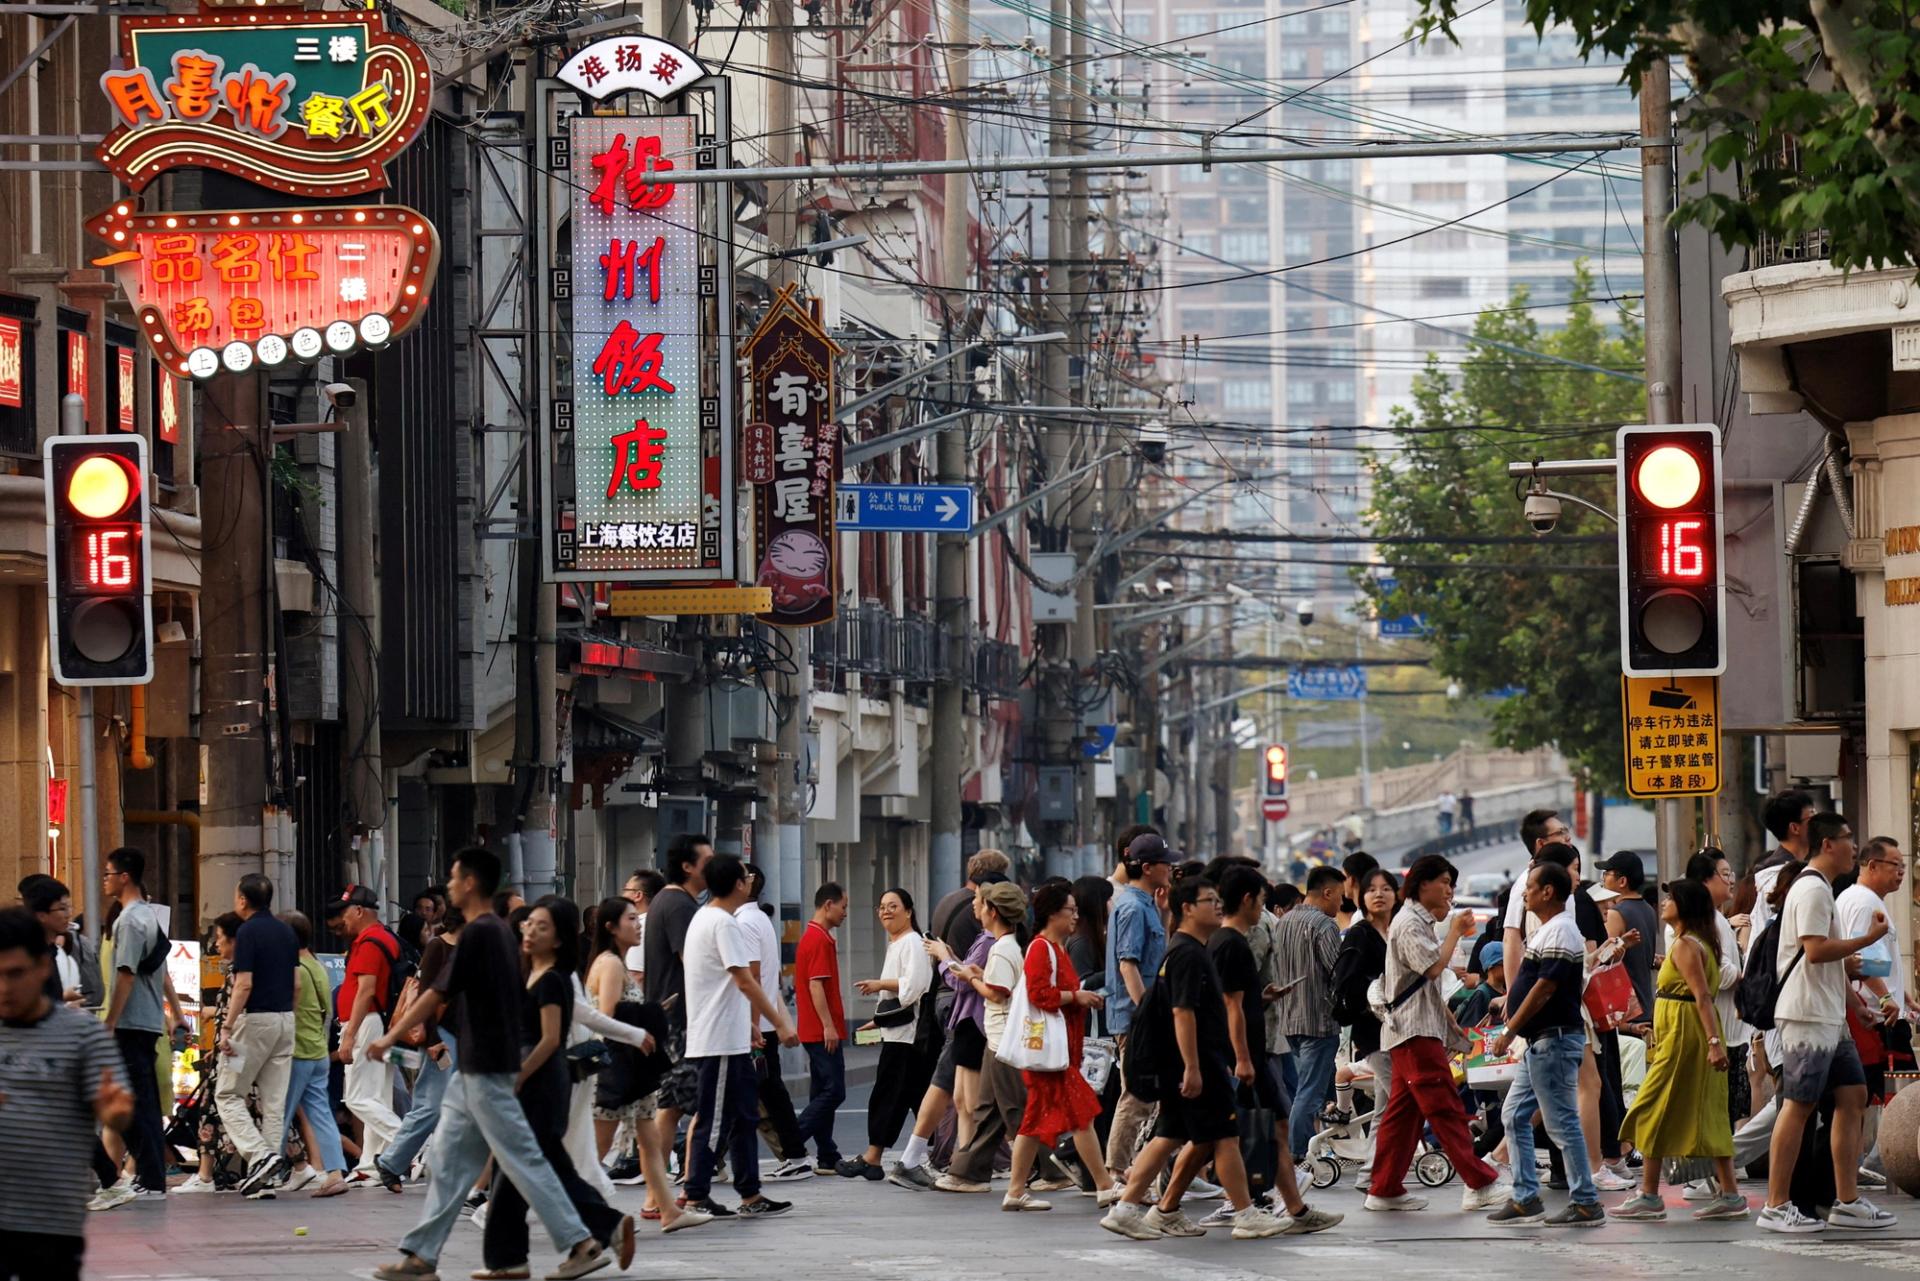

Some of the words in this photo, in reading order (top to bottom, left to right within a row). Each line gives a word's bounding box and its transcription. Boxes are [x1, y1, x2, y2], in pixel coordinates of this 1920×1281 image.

[294, 36, 358, 62] 三楼
[577, 44, 683, 88] 淮扬菜
[304, 83, 391, 139] 餐厅
[174, 297, 266, 333] 汤包
[753, 427, 766, 480] 日本料理
[768, 371, 816, 523] 有喜屋
[810, 424, 838, 497] 深夜食堂
[899, 504, 922, 512] TOILET
[579, 523, 696, 548] 上海餐饮名店
[1661, 522, 1702, 575] 16
[88, 531, 132, 585] 16
[1630, 713, 1713, 731] 停车行为违法
[1639, 733, 1708, 749] 请立即驶离
[1632, 752, 1714, 770] 电子警察监管
